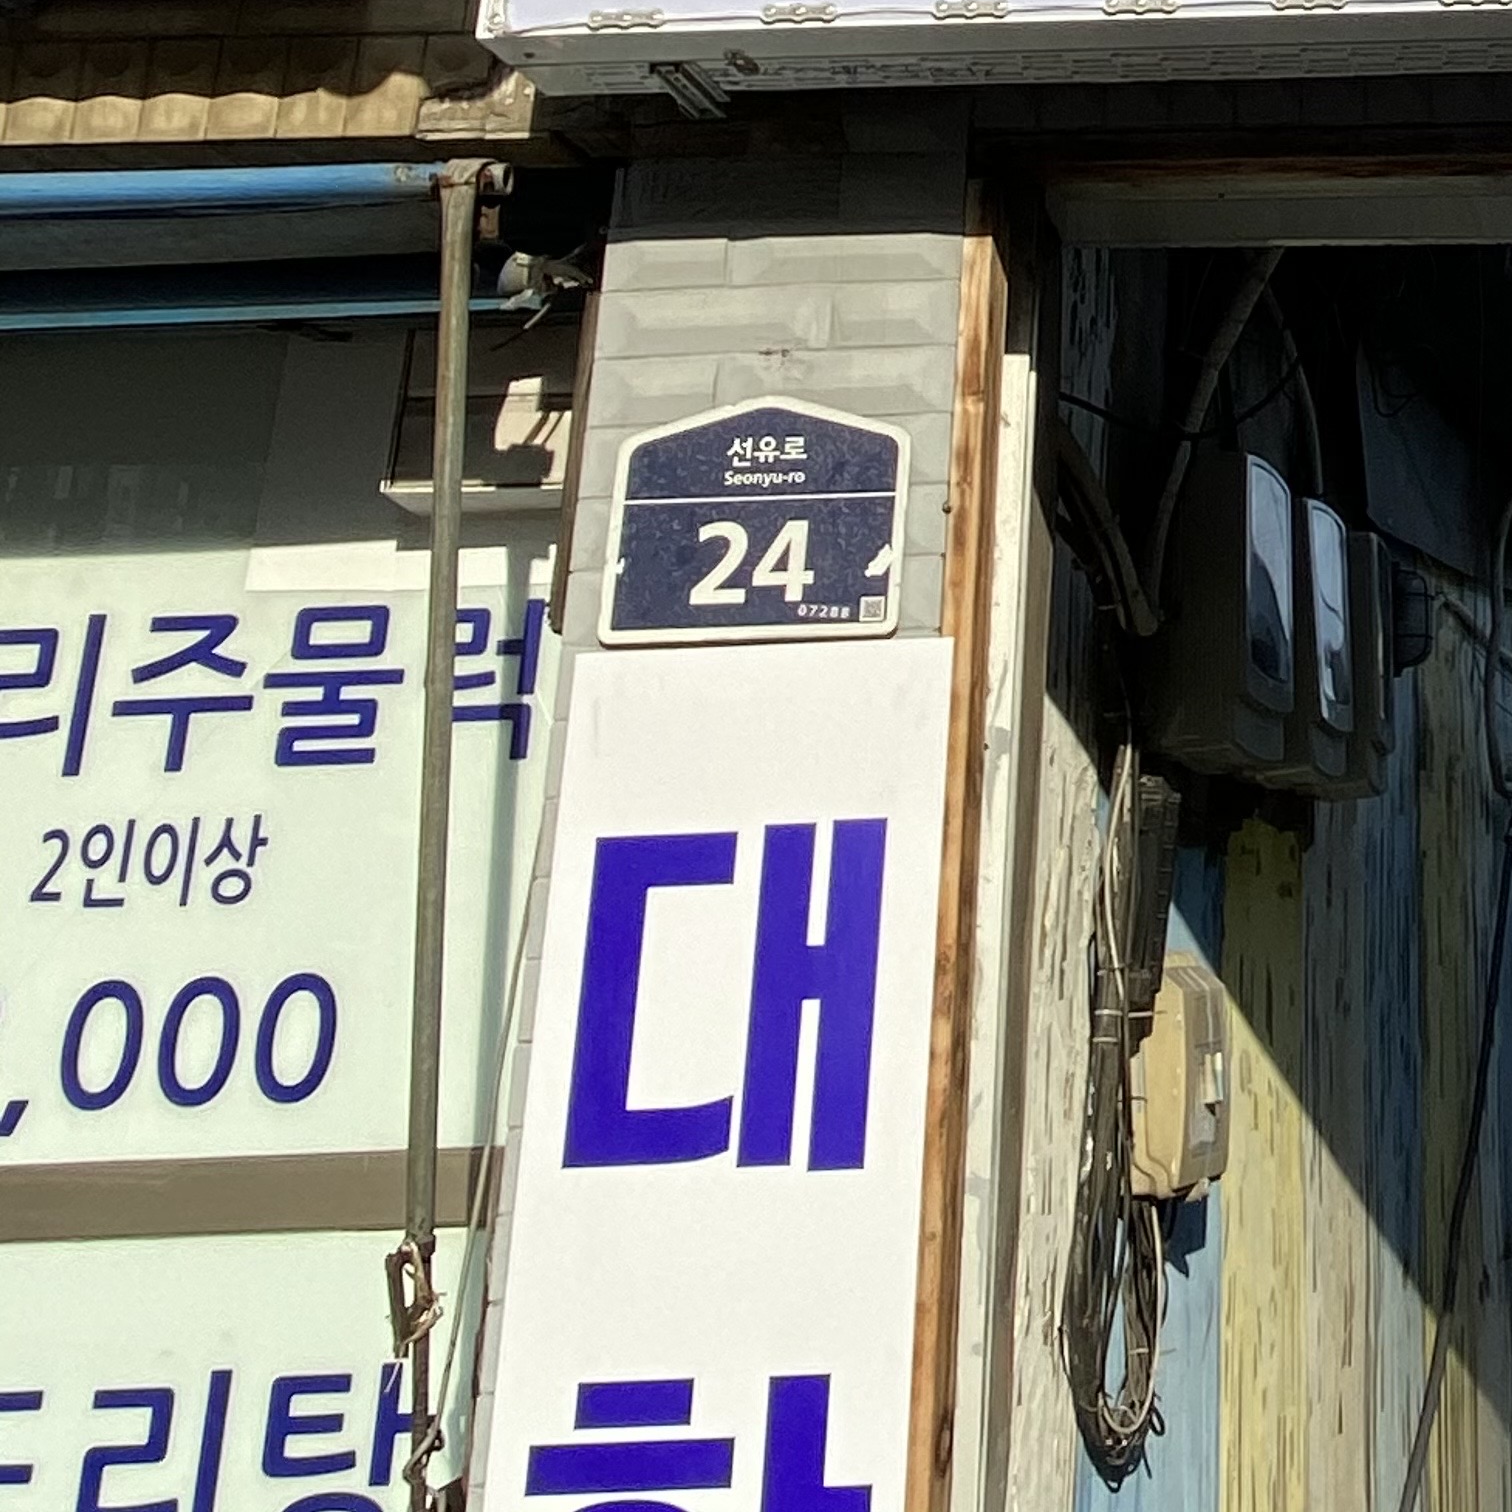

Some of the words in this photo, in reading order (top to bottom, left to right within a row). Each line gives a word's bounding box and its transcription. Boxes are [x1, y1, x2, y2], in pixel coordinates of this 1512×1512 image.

[724, 470, 806, 488] Seonyu-ro
[727, 436, 808, 468] 선유로
[689, 519, 815, 606] 24
[28, 814, 269, 908] 2인이상
